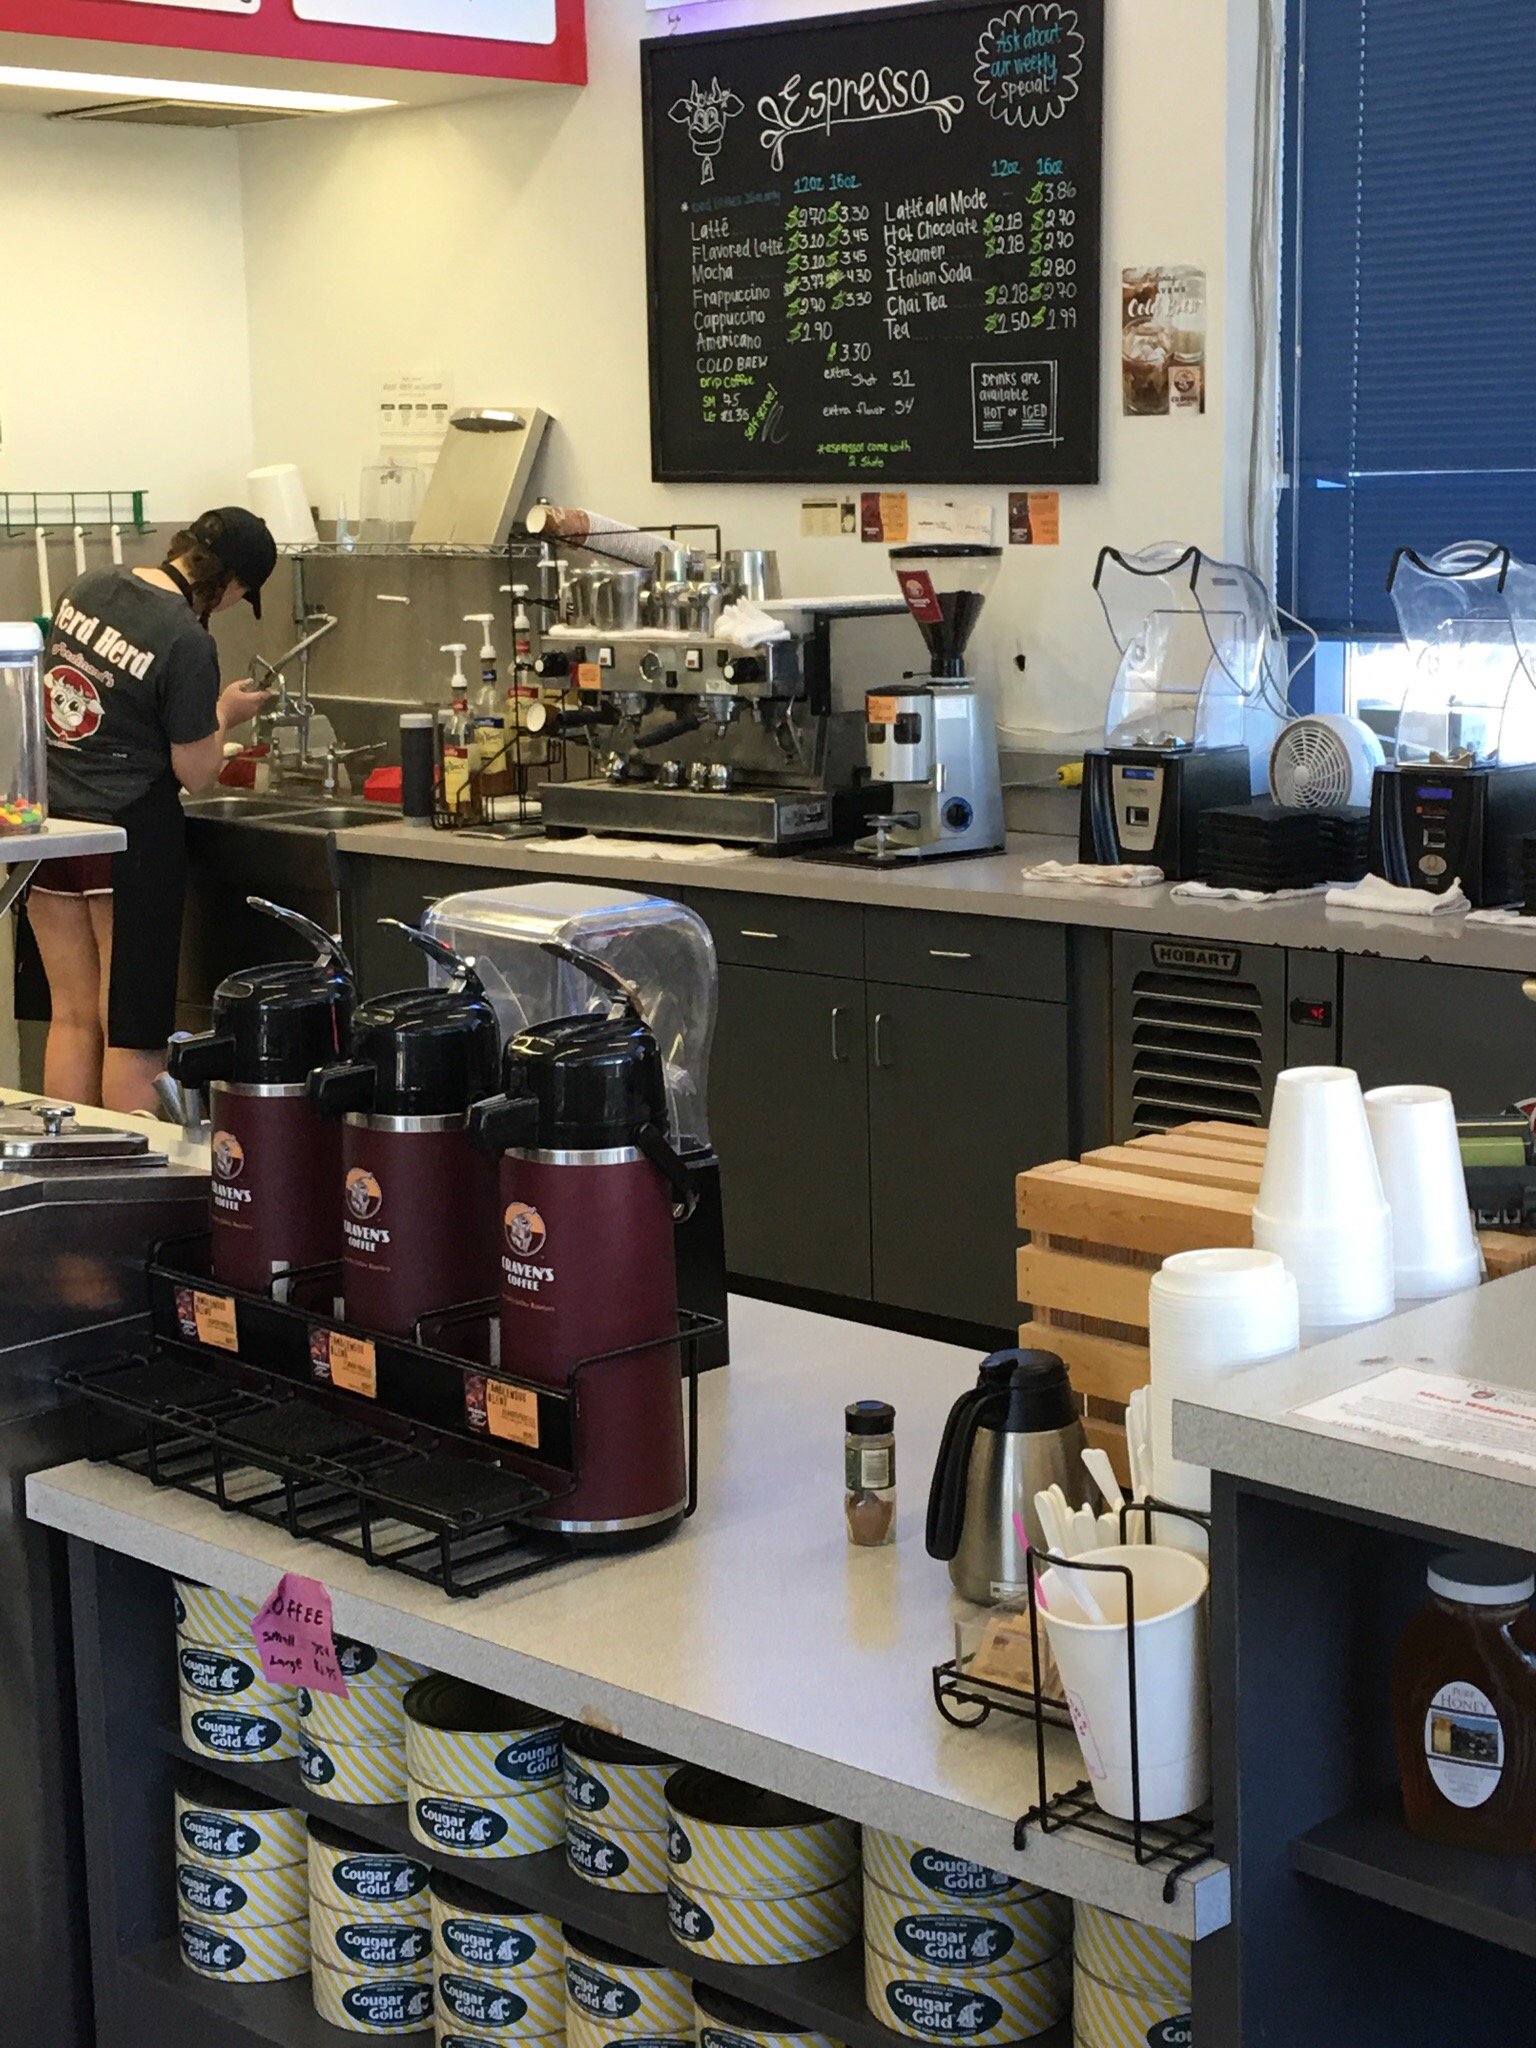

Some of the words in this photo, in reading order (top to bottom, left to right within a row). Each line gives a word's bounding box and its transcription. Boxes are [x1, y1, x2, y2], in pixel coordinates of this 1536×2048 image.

[1000, 74, 1050, 103] special
[780, 66, 930, 136] Espresso
[951, 187, 989, 215] Mode
[884, 223, 914, 246] Hot
[917, 217, 979, 241] Chocolate
[692, 238, 751, 263] Flavored
[692, 264, 734, 284] Mocha
[886, 268, 937, 291] Italian
[938, 261, 973, 284] Soda
[692, 284, 771, 310] Frappuccino
[887, 292, 921, 316] Chai
[922, 291, 948, 312] Tea
[694, 305, 766, 333] Cappuccino
[883, 318, 911, 340] Tea
[696, 330, 762, 352] Americano
[696, 357, 734, 374] COLD
[1021, 372, 1042, 386] are
[979, 388, 1030, 402] available
[983, 406, 1006, 420] HOT
[1008, 408, 1018, 417] or
[1022, 404, 1048, 420] ICED
[93, 626, 154, 680] Herd
[1160, 947, 1231, 967] HOBART
[507, 1273, 540, 1292] COFFEE
[267, 1596, 323, 1625] OFFEE
[182, 1656, 217, 1676] Cougar
[191, 1673, 218, 1689] Gold
[1440, 1694, 1489, 1713] HONEY
[197, 1718, 242, 1738] Cougar
[210, 1733, 242, 1748] Gold
[421, 1805, 466, 1828] Cougar
[183, 1818, 222, 1838] Cougar
[433, 1824, 466, 1841] Gold
[194, 1836, 222, 1852] Gold
[341, 1866, 392, 1886] Cougar
[944, 1873, 987, 1889] Gold
[356, 1879, 391, 1895] Gold
[344, 1932, 397, 1952] Cougar
[447, 1926, 494, 1948] Cougar
[905, 1923, 967, 1947] Cougar
[361, 1945, 397, 1960] Gold
[461, 1944, 494, 1961] Gold
[924, 1943, 967, 1959] Gold
[351, 1993, 404, 2011] Cougar
[444, 1980, 485, 2005] Cougar
[895, 1988, 953, 2014] Cougar
[369, 2004, 404, 2020] Gold
[454, 2002, 485, 2019] Gold
[912, 2010, 953, 2029] Gold
